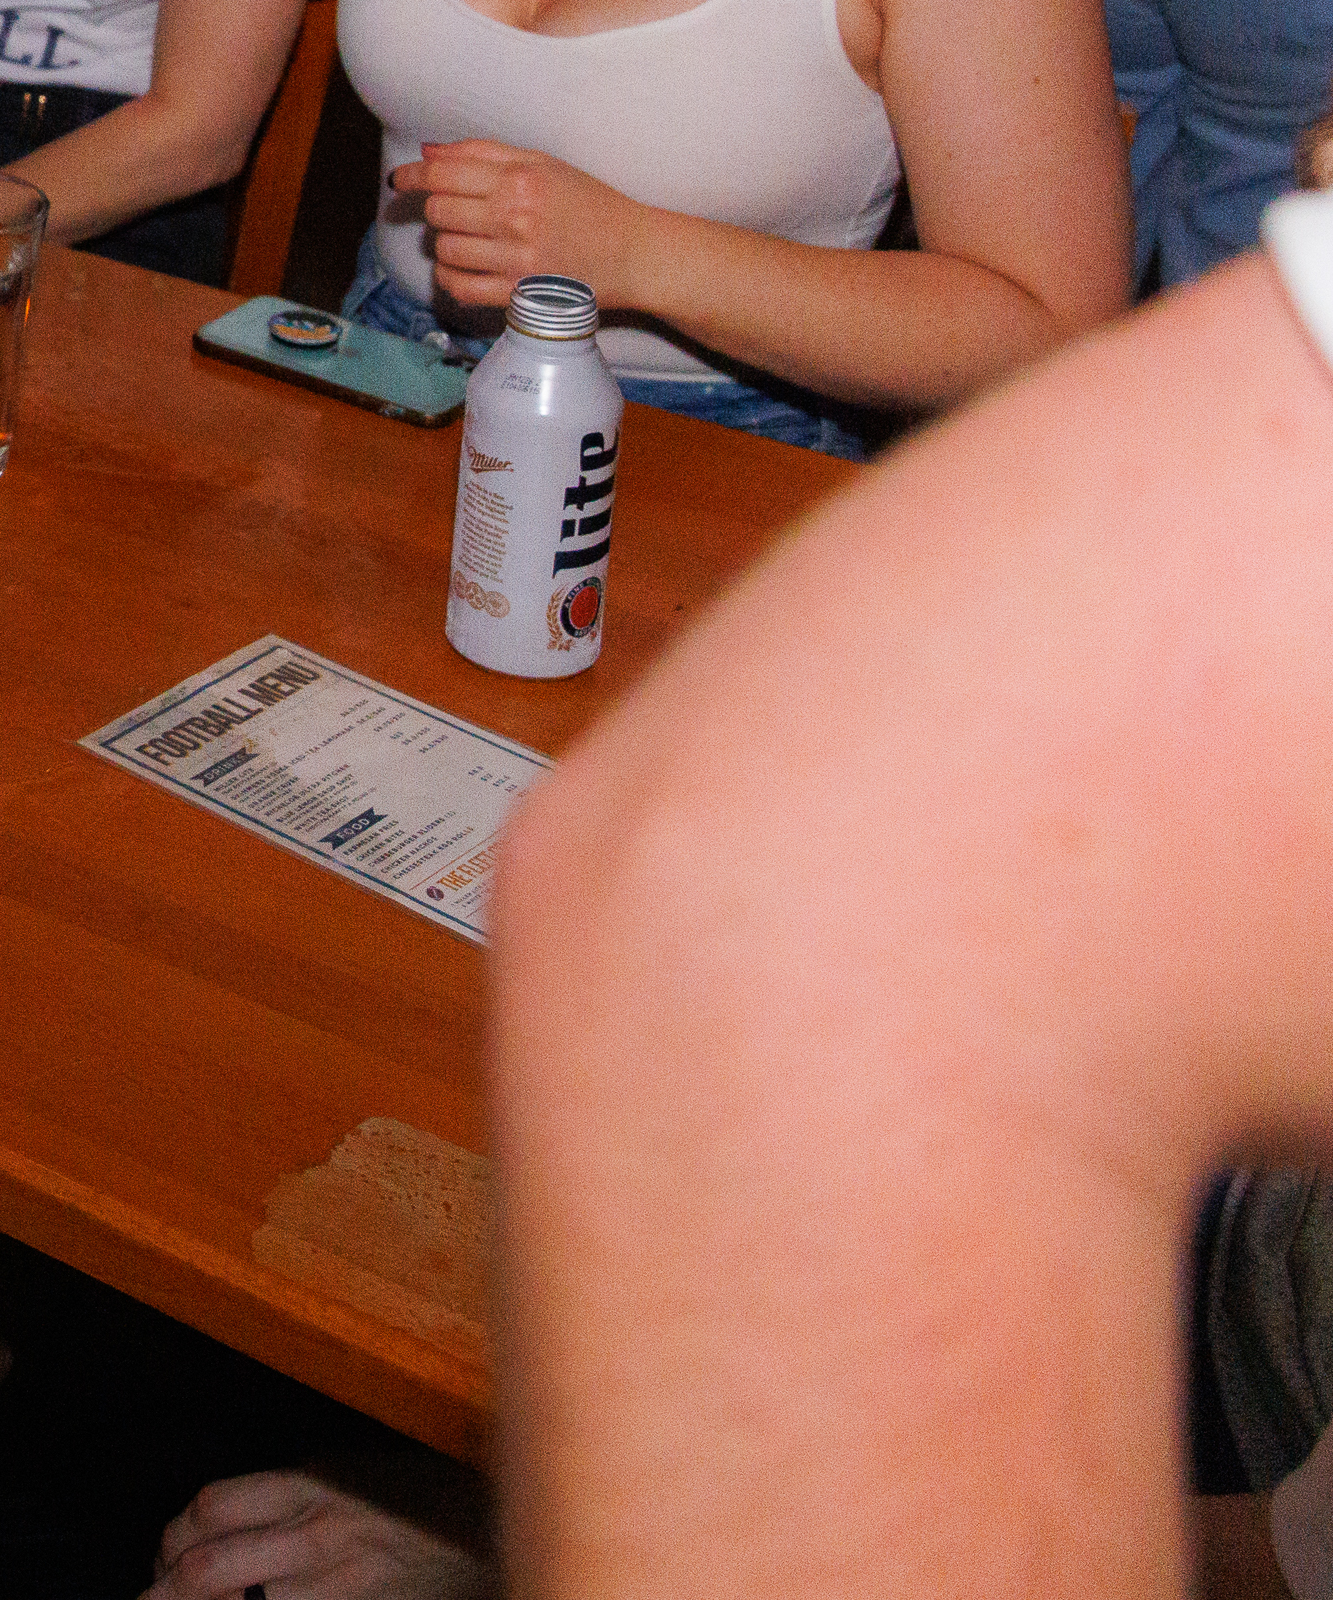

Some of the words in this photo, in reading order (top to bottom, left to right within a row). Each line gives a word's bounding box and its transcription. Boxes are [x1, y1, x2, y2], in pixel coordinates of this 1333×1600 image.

[467, 445, 513, 471] Miller
[551, 428, 619, 579] lite
[135, 697, 264, 766] FOOTBALL
[237, 661, 320, 706] MENU
[334, 818, 371, 839] FOOD
[367, 835, 417, 867] CHEESEBURGER
[416, 818, 444, 834] SLIDERS
[383, 830, 404, 842] BITES
[378, 854, 409, 873] CHICKEN
[408, 837, 437, 854] NACHOS
[391, 850, 438, 879] CHEESESTEAK
[436, 841, 453, 850] EGG
[450, 827, 474, 841] ROLLS
[435, 871, 473, 891] THE
